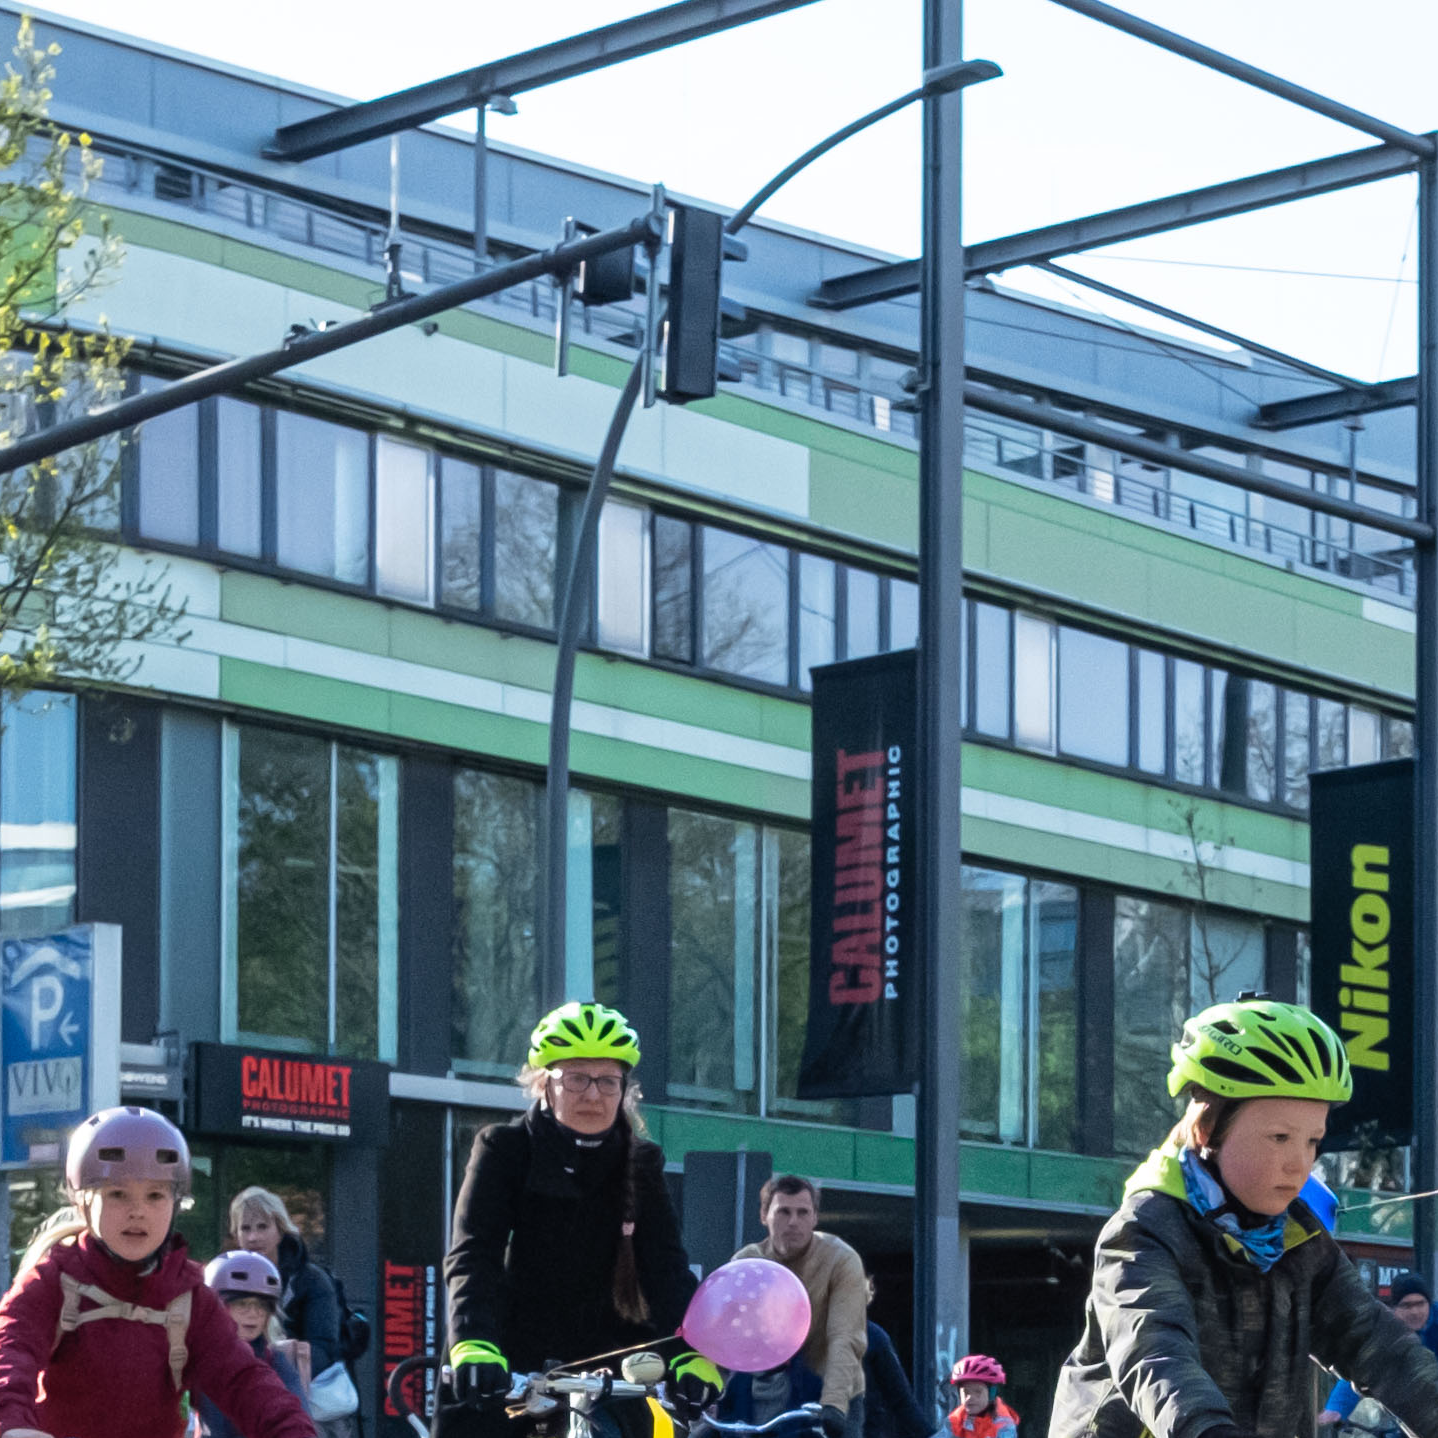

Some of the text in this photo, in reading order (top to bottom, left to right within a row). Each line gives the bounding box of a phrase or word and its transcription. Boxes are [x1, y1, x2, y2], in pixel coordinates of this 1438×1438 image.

[829, 748, 885, 1006] CALUMET
[884, 745, 902, 1000] PHOTOGRAPHIC
[1338, 843, 1391, 1072] Nikon
[241, 1055, 352, 1106] CALUMET
[243, 1100, 350, 1119] PHOTOGRAPHIC
